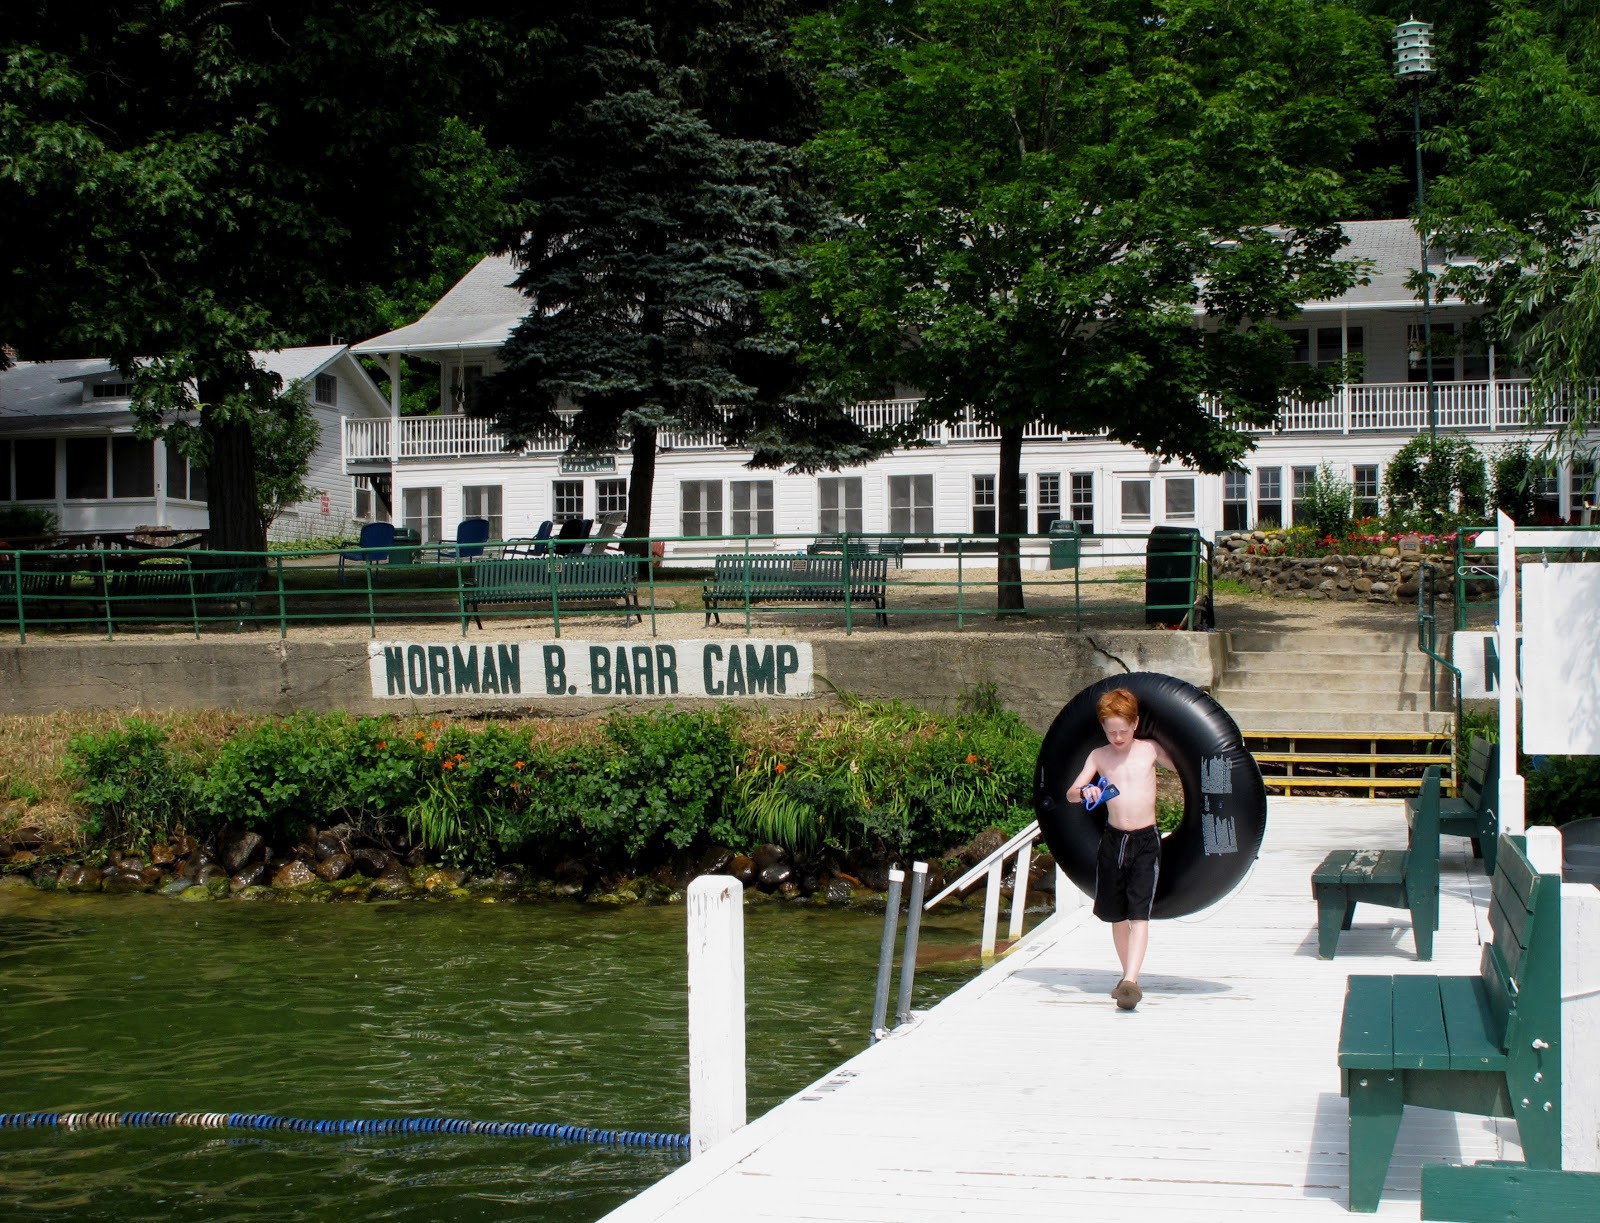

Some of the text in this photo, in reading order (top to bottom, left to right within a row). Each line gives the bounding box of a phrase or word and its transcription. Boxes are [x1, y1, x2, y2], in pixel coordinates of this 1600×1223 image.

[384, 643, 799, 696] NORMAN B. BARR CAMP
